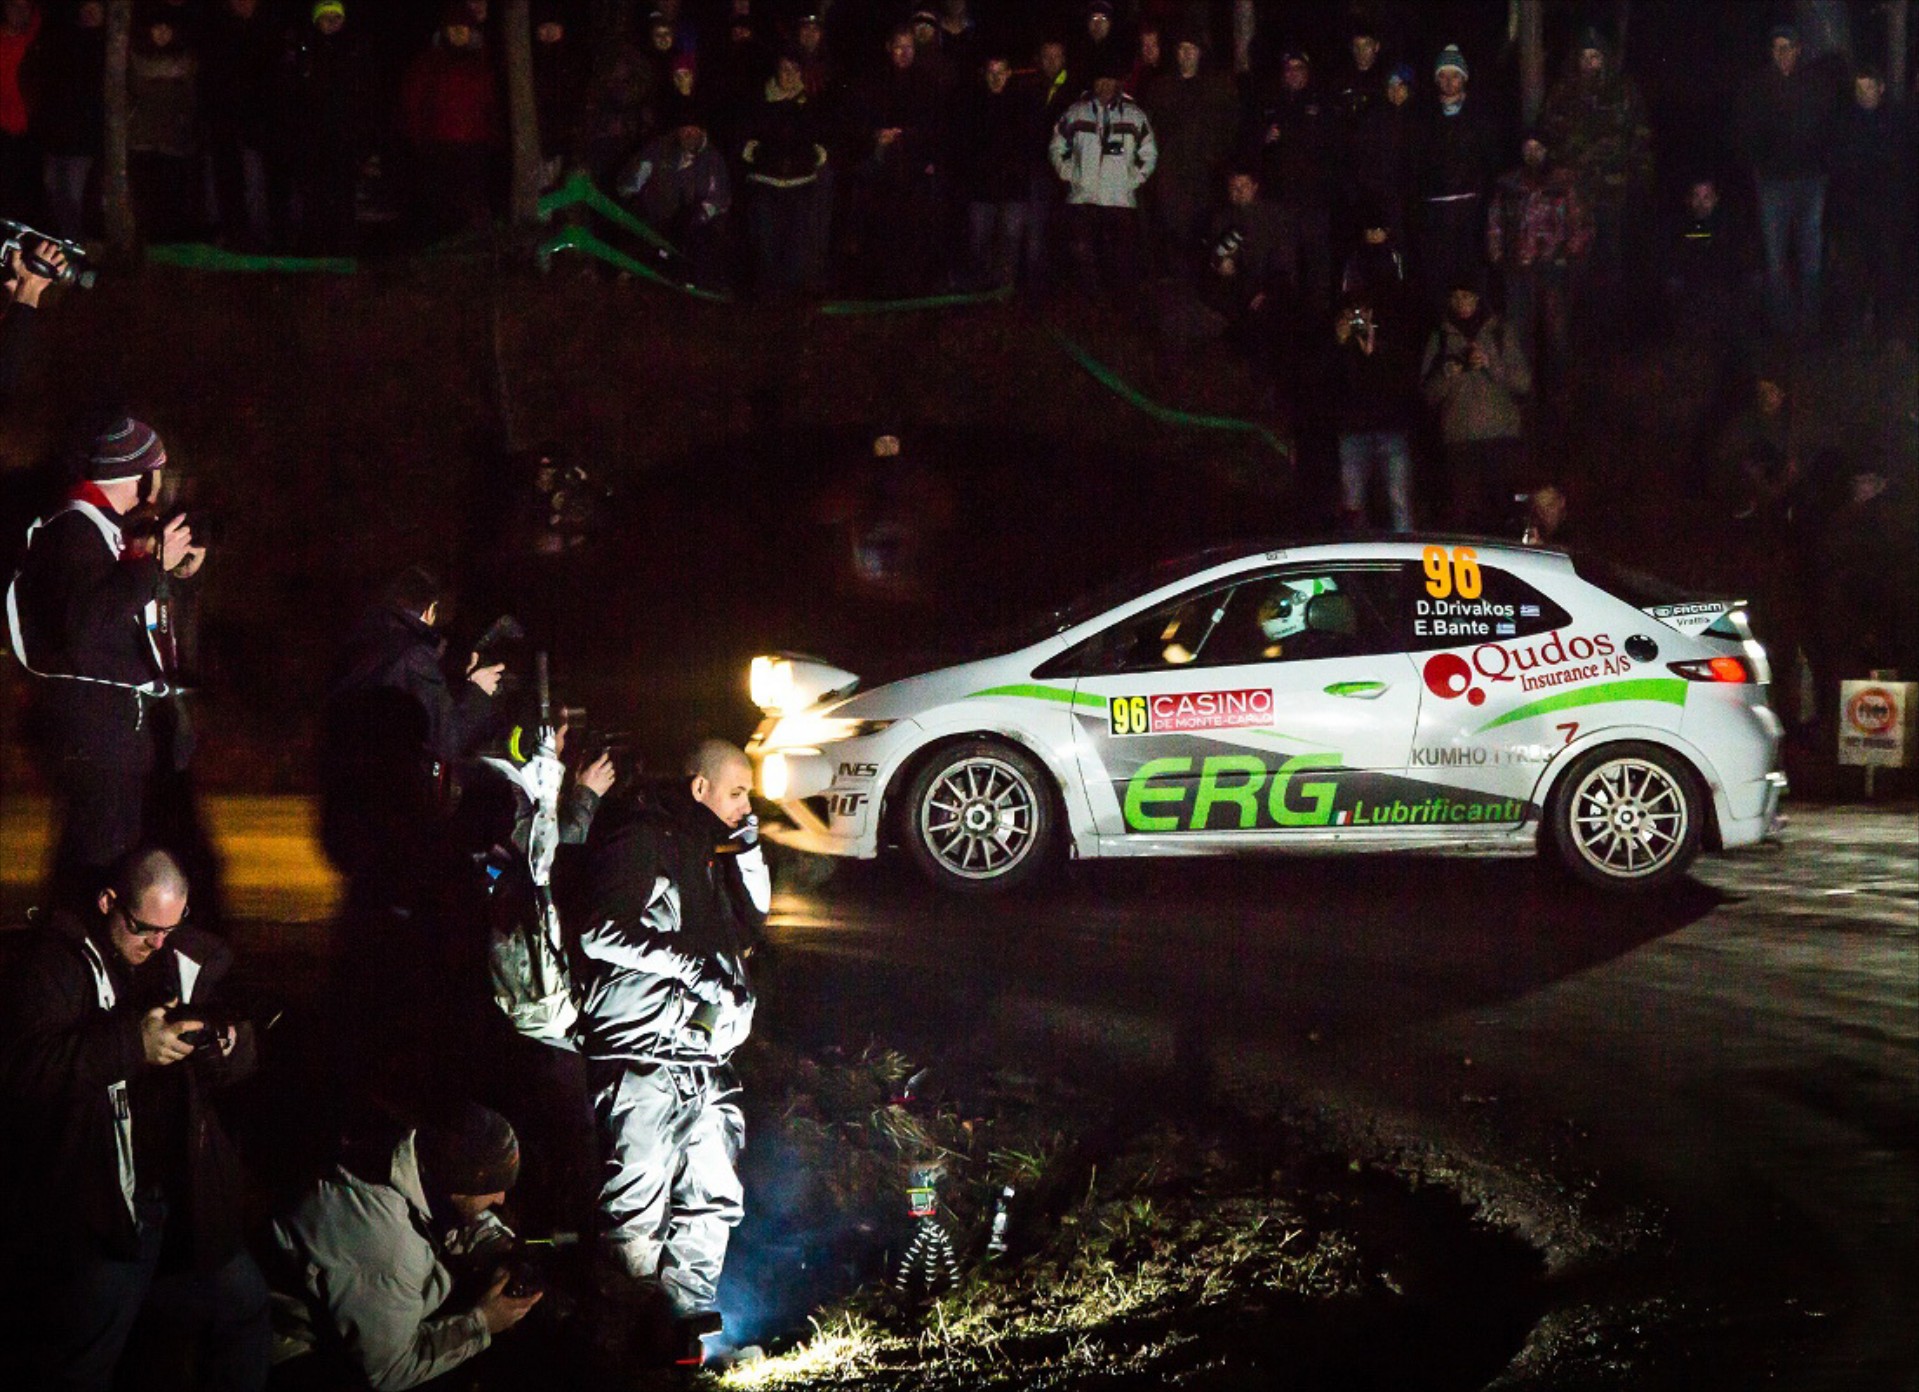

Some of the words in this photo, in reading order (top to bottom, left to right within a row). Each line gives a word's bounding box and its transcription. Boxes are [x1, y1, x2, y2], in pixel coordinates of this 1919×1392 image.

[1423, 545, 1483, 599] 96
[1417, 600, 1515, 616] D.Drivakos
[1415, 619, 1490, 635] E.Bante
[1472, 630, 1615, 682] Qudos
[1520, 664, 1599, 692] Insurance
[1604, 655, 1631, 676] A/S
[1113, 696, 1146, 734] 96
[1154, 690, 1271, 718] CASINO
[1155, 718, 1173, 729] DE
[1175, 713, 1273, 728] MONTE-CARLO
[1412, 748, 1486, 765] KUMHO
[1124, 752, 1343, 831] ERG
[1353, 798, 1523, 824] Lubrificanti
